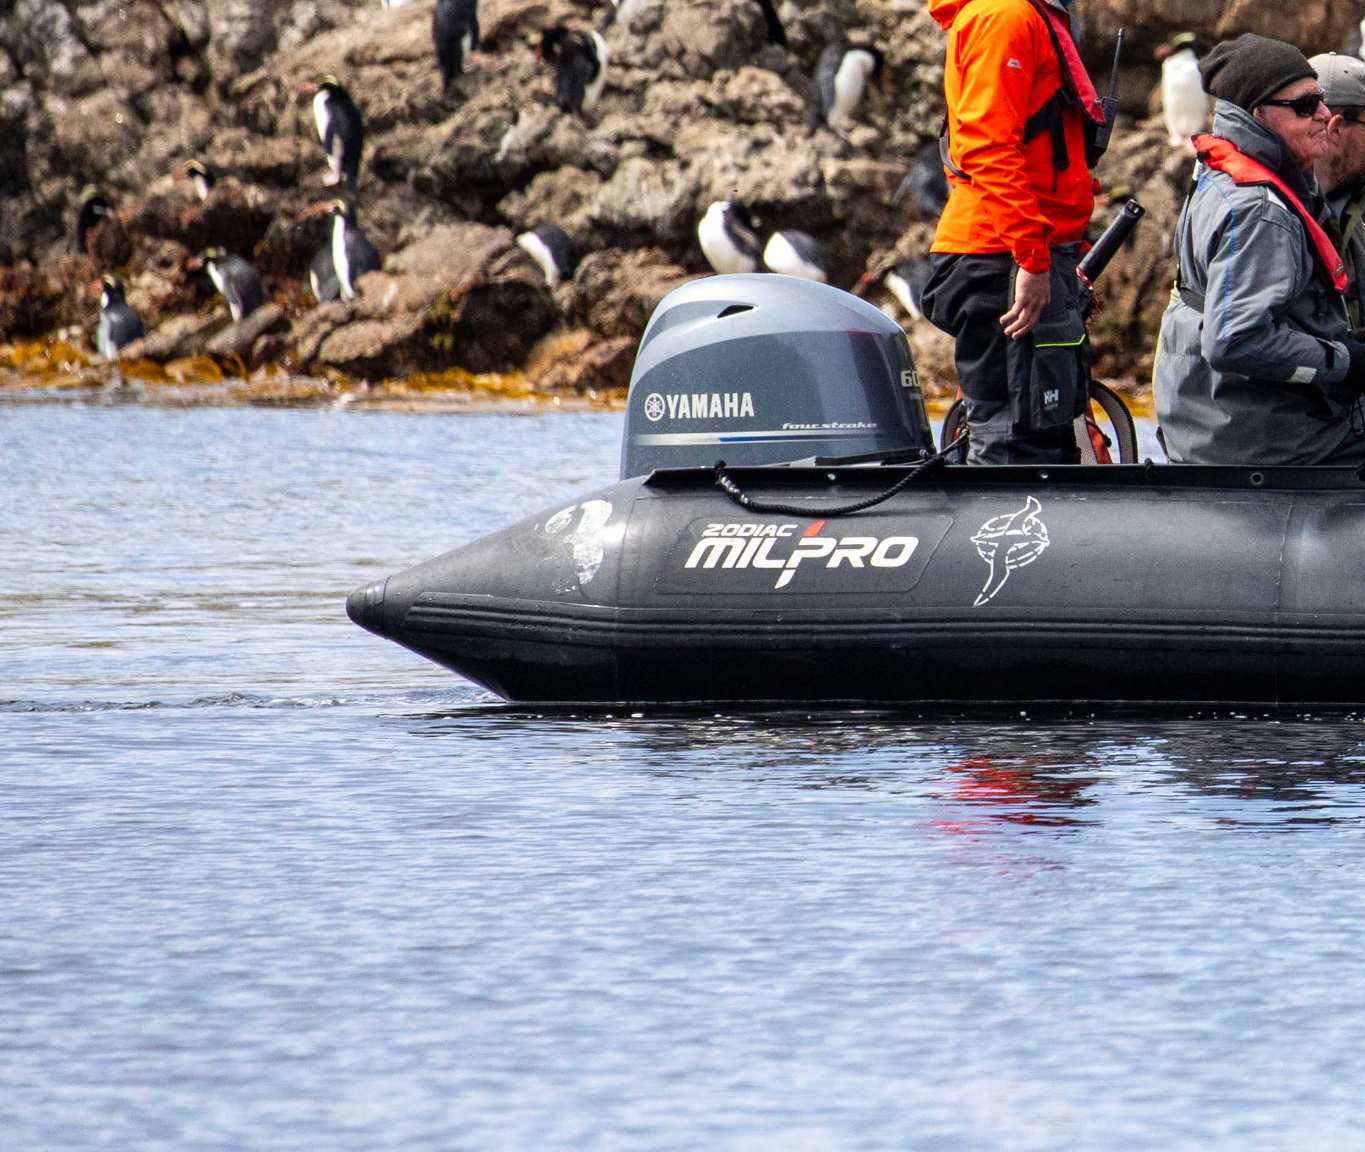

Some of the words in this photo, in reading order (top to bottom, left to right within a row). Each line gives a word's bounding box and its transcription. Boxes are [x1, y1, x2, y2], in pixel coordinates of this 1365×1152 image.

[665, 392, 755, 419] YAMAHA
[701, 523, 798, 537] ZODIAC
[684, 535, 919, 590] MILPRO
